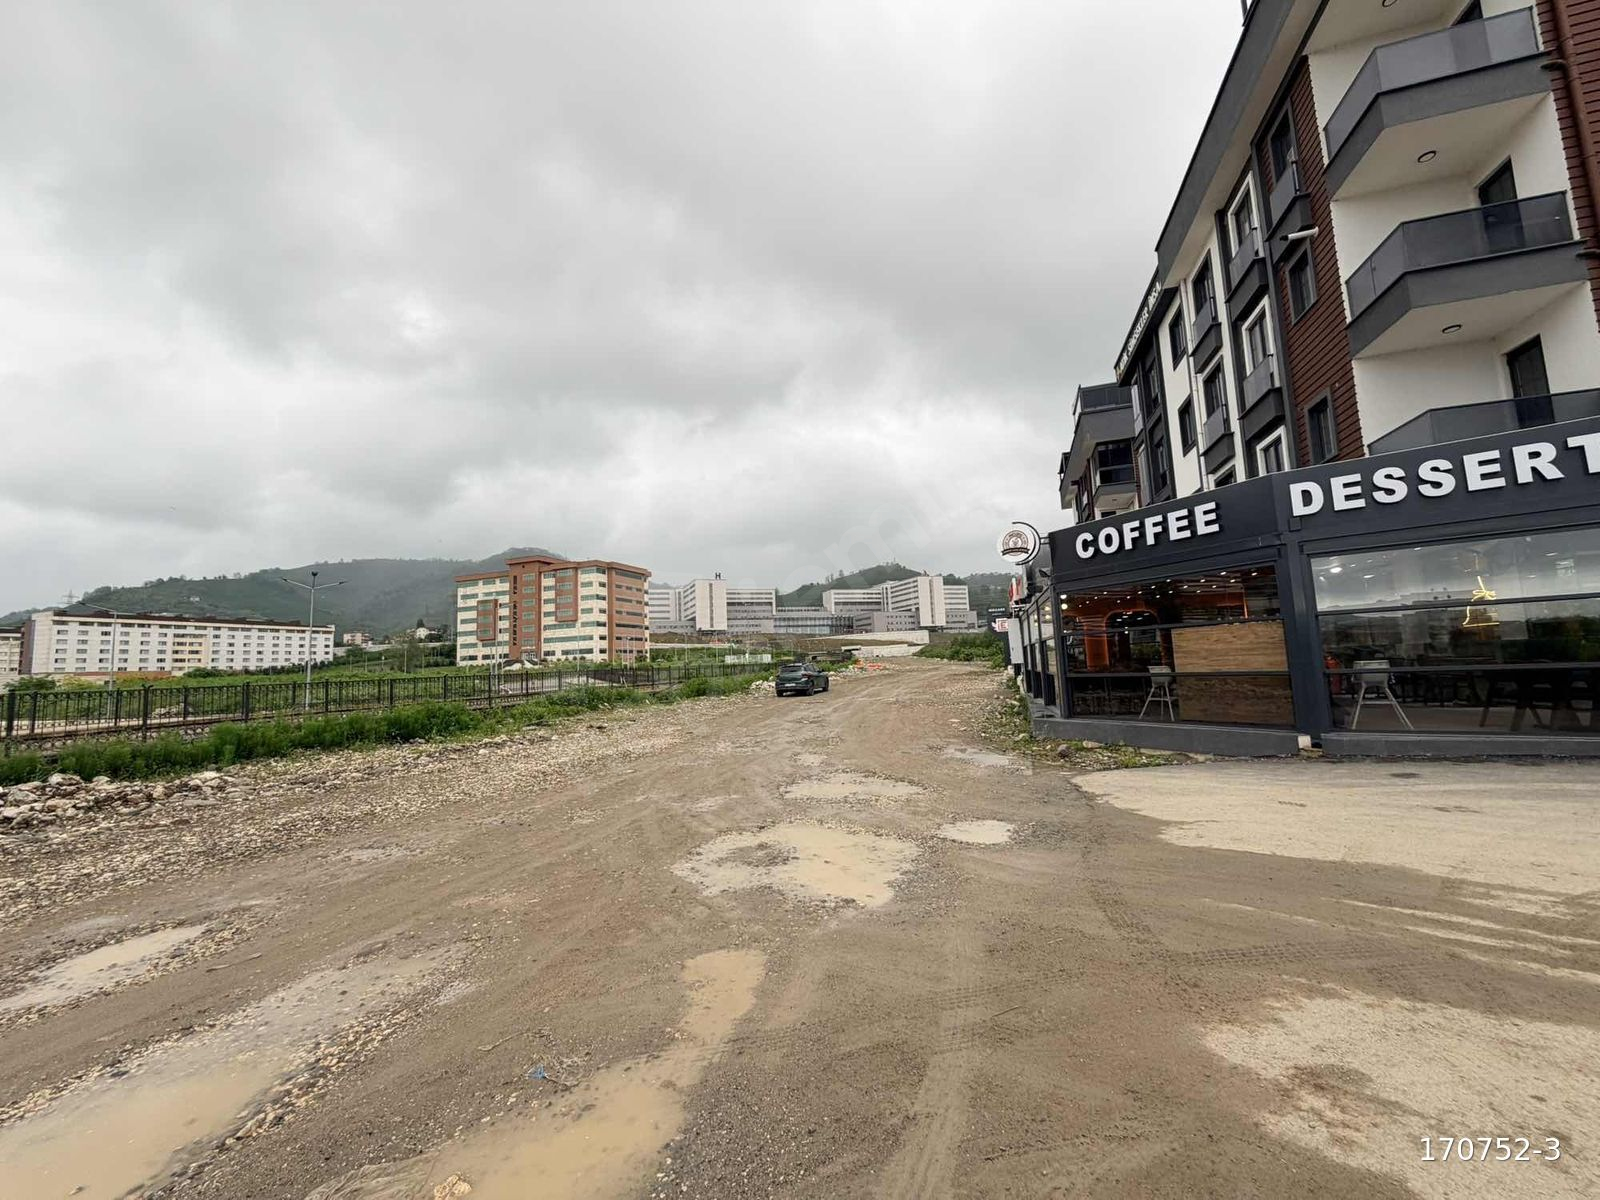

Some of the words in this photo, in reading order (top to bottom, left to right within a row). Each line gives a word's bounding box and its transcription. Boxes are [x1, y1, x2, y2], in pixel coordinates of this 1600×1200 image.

[1289, 433, 1600, 516] DESSERT
[1075, 501, 1220, 559] COFFEE
[715, 572, 721, 580] H
